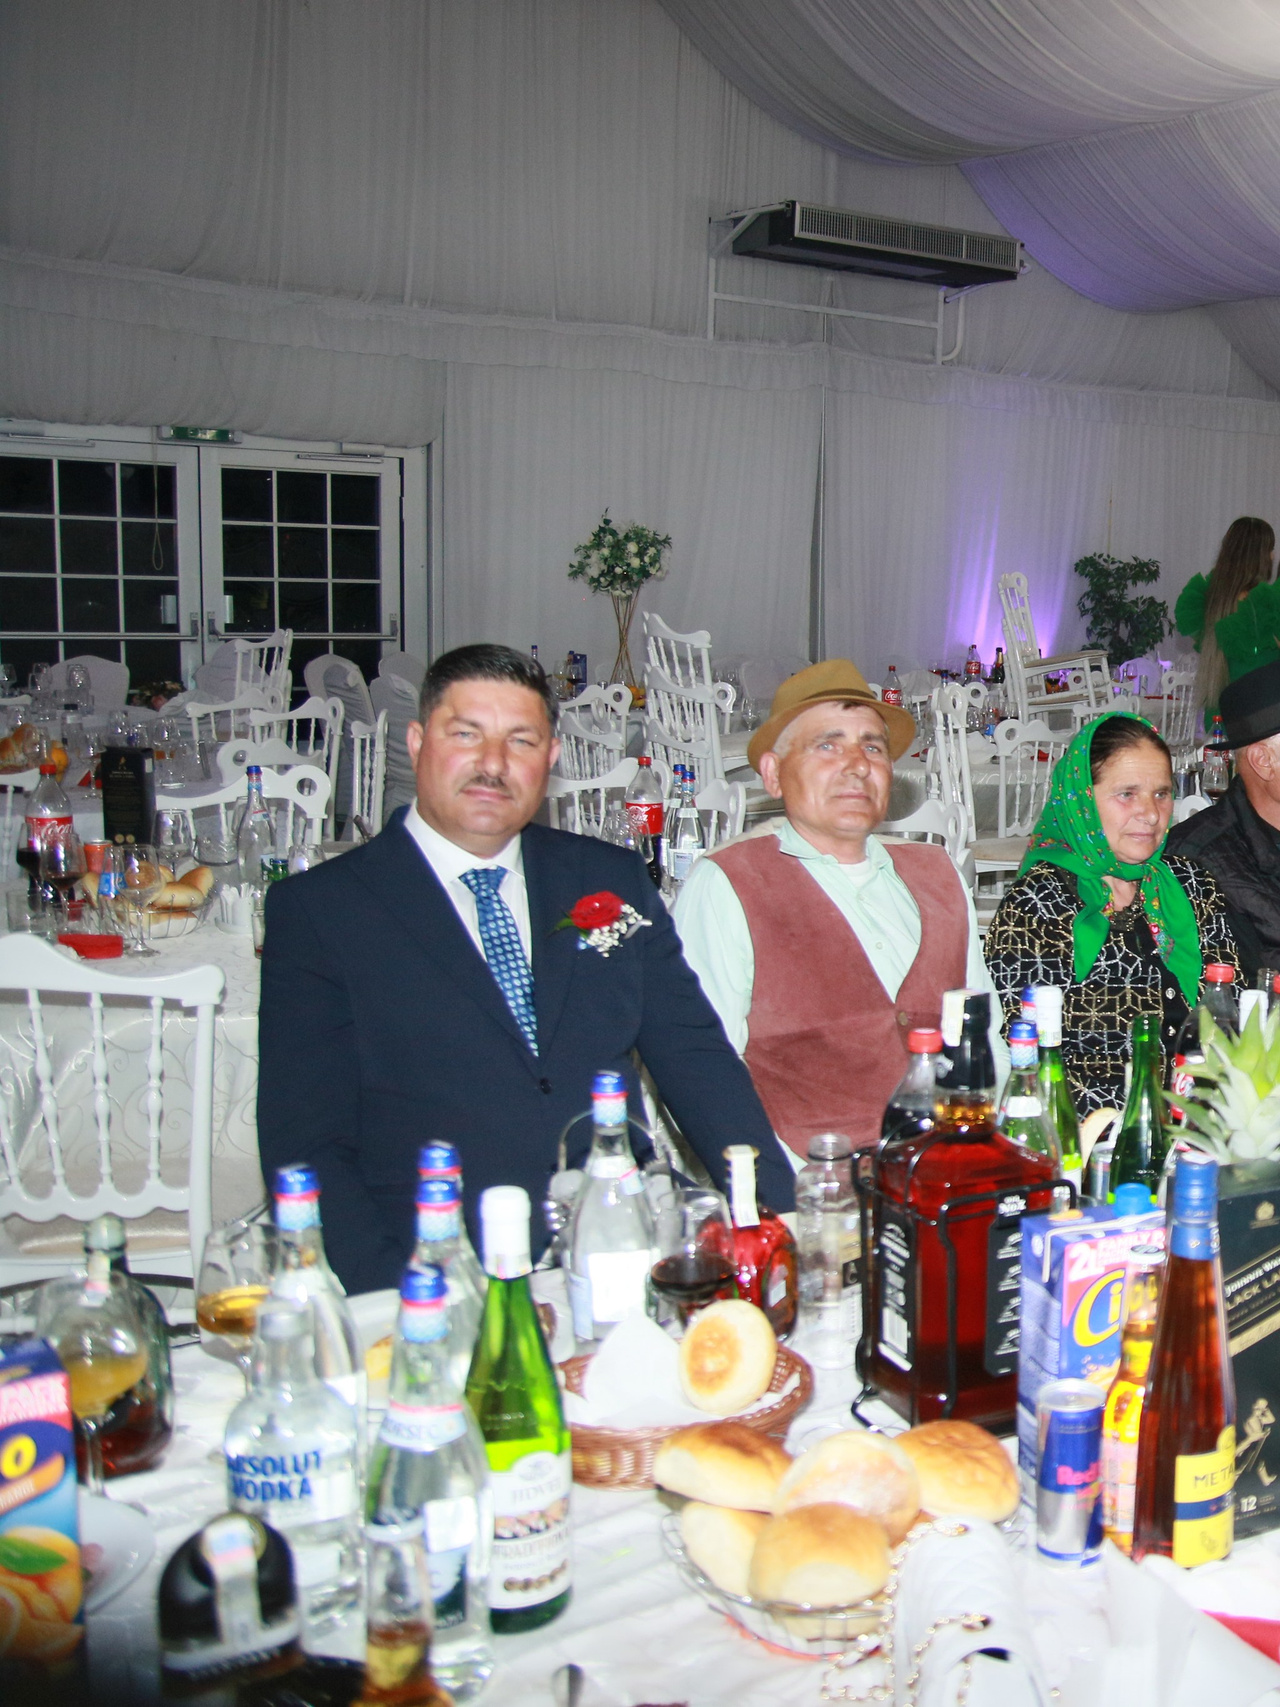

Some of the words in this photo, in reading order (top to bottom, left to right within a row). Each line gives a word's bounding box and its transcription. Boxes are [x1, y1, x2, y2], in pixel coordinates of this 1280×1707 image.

[1069, 1243, 1106, 1282] 2L
[1073, 1269, 1126, 1348] Ci
[1193, 1466, 1235, 1489] META
[1241, 1495, 1257, 1513] 12
